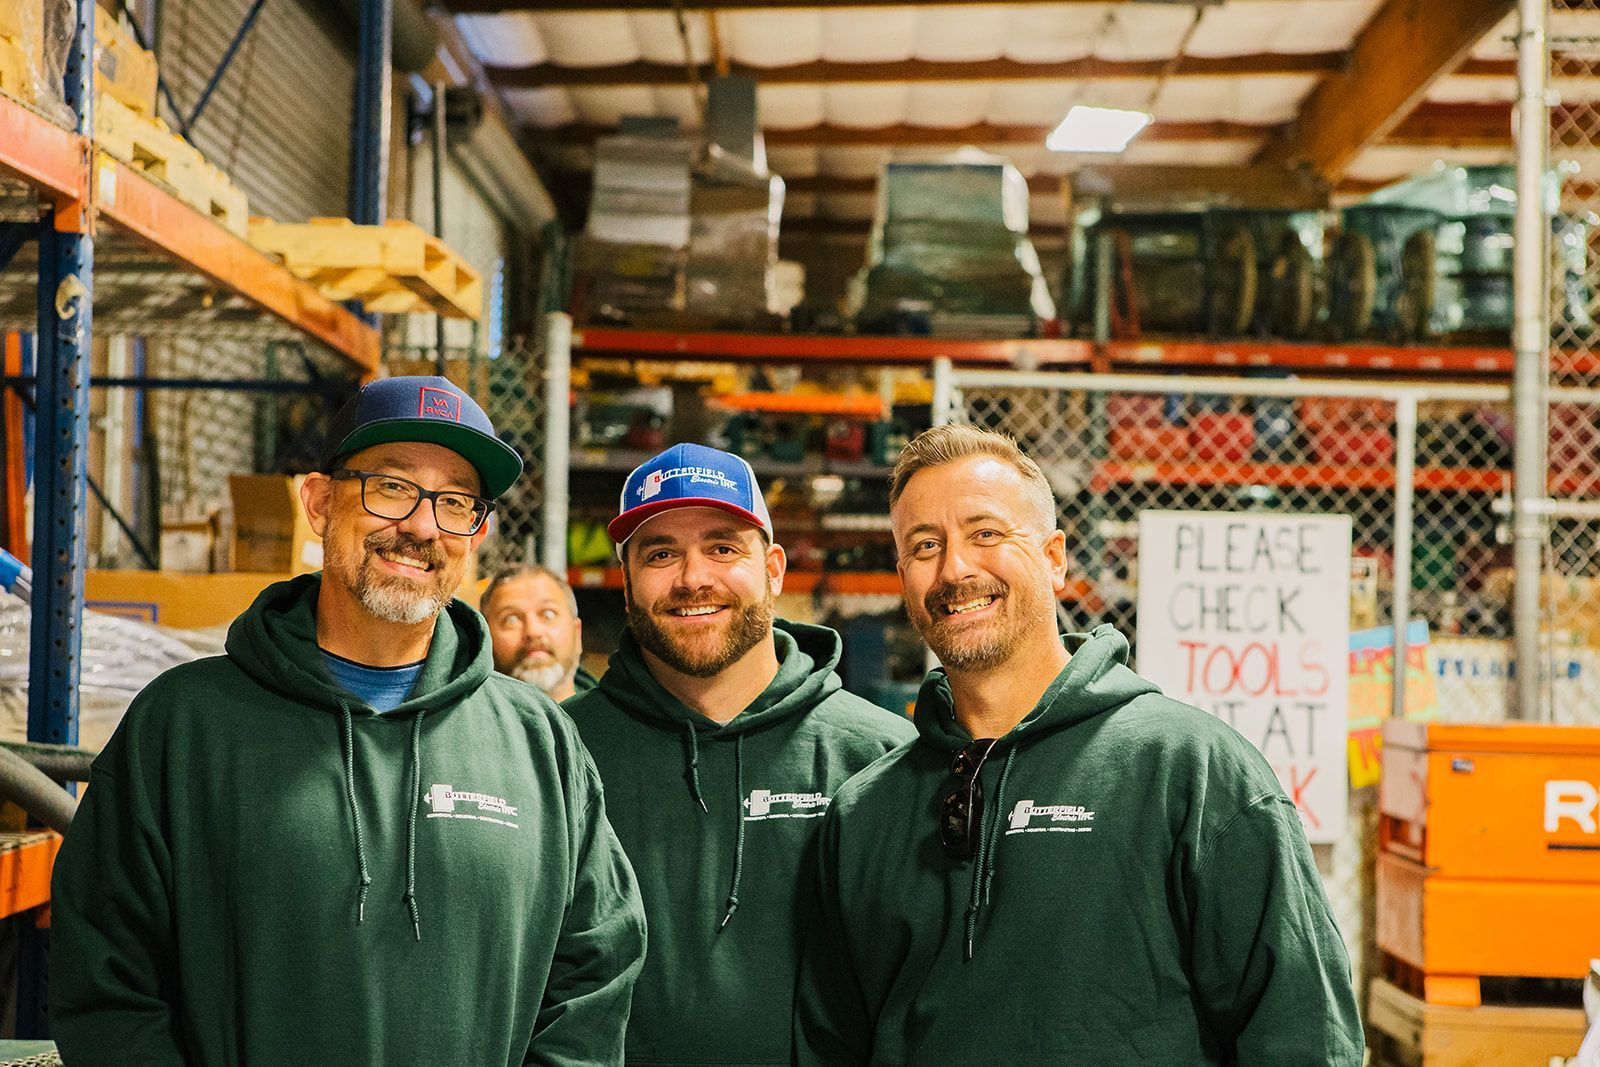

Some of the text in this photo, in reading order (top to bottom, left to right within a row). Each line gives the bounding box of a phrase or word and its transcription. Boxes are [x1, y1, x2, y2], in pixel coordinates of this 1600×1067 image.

[432, 397, 449, 409] VA
[654, 466, 725, 483] BUTTERFIELD
[1174, 523, 1321, 574] PLEASE
[1167, 582, 1304, 635] CHECK
[1178, 639, 1330, 697] TOOLS
[1262, 702, 1326, 757] AT
